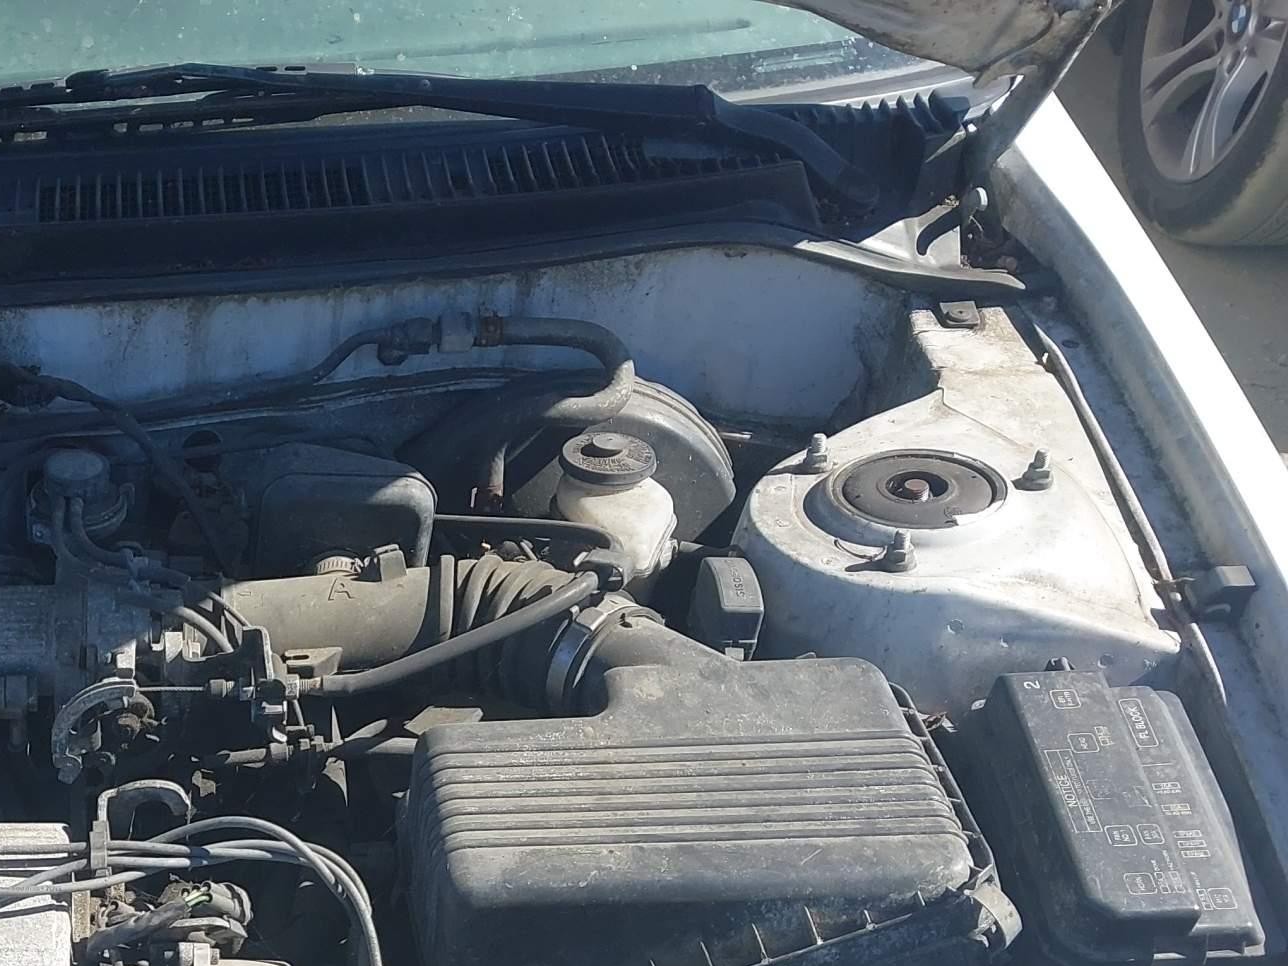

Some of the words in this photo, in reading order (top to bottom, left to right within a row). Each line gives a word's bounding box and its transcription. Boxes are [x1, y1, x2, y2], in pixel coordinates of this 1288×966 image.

[1024, 680, 1040, 689] 2
[1127, 706, 1146, 730] BLOCK
[1056, 774, 1078, 808] NOTICE
